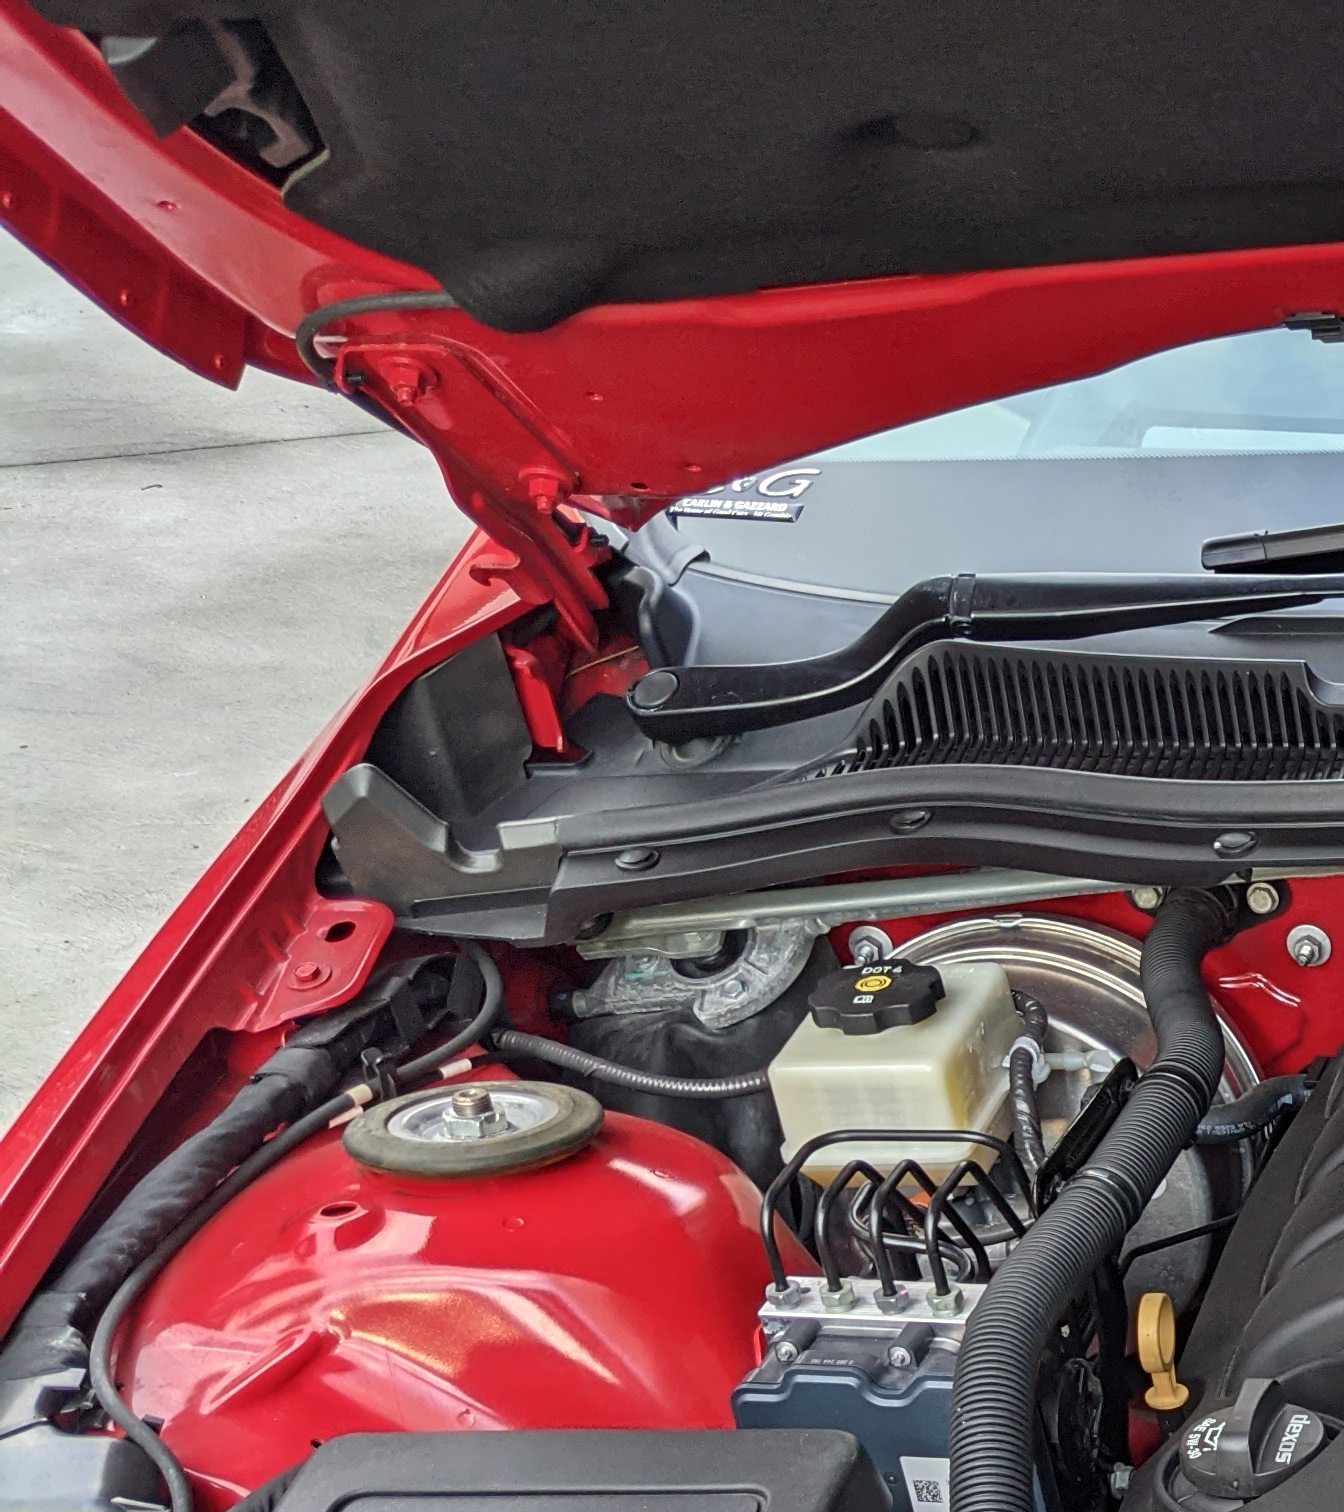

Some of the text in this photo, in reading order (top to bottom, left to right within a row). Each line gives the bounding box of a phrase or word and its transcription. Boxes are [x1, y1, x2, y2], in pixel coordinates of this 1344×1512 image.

[861, 965, 903, 975] DOT 4
[1275, 1414, 1312, 1465] dexos
